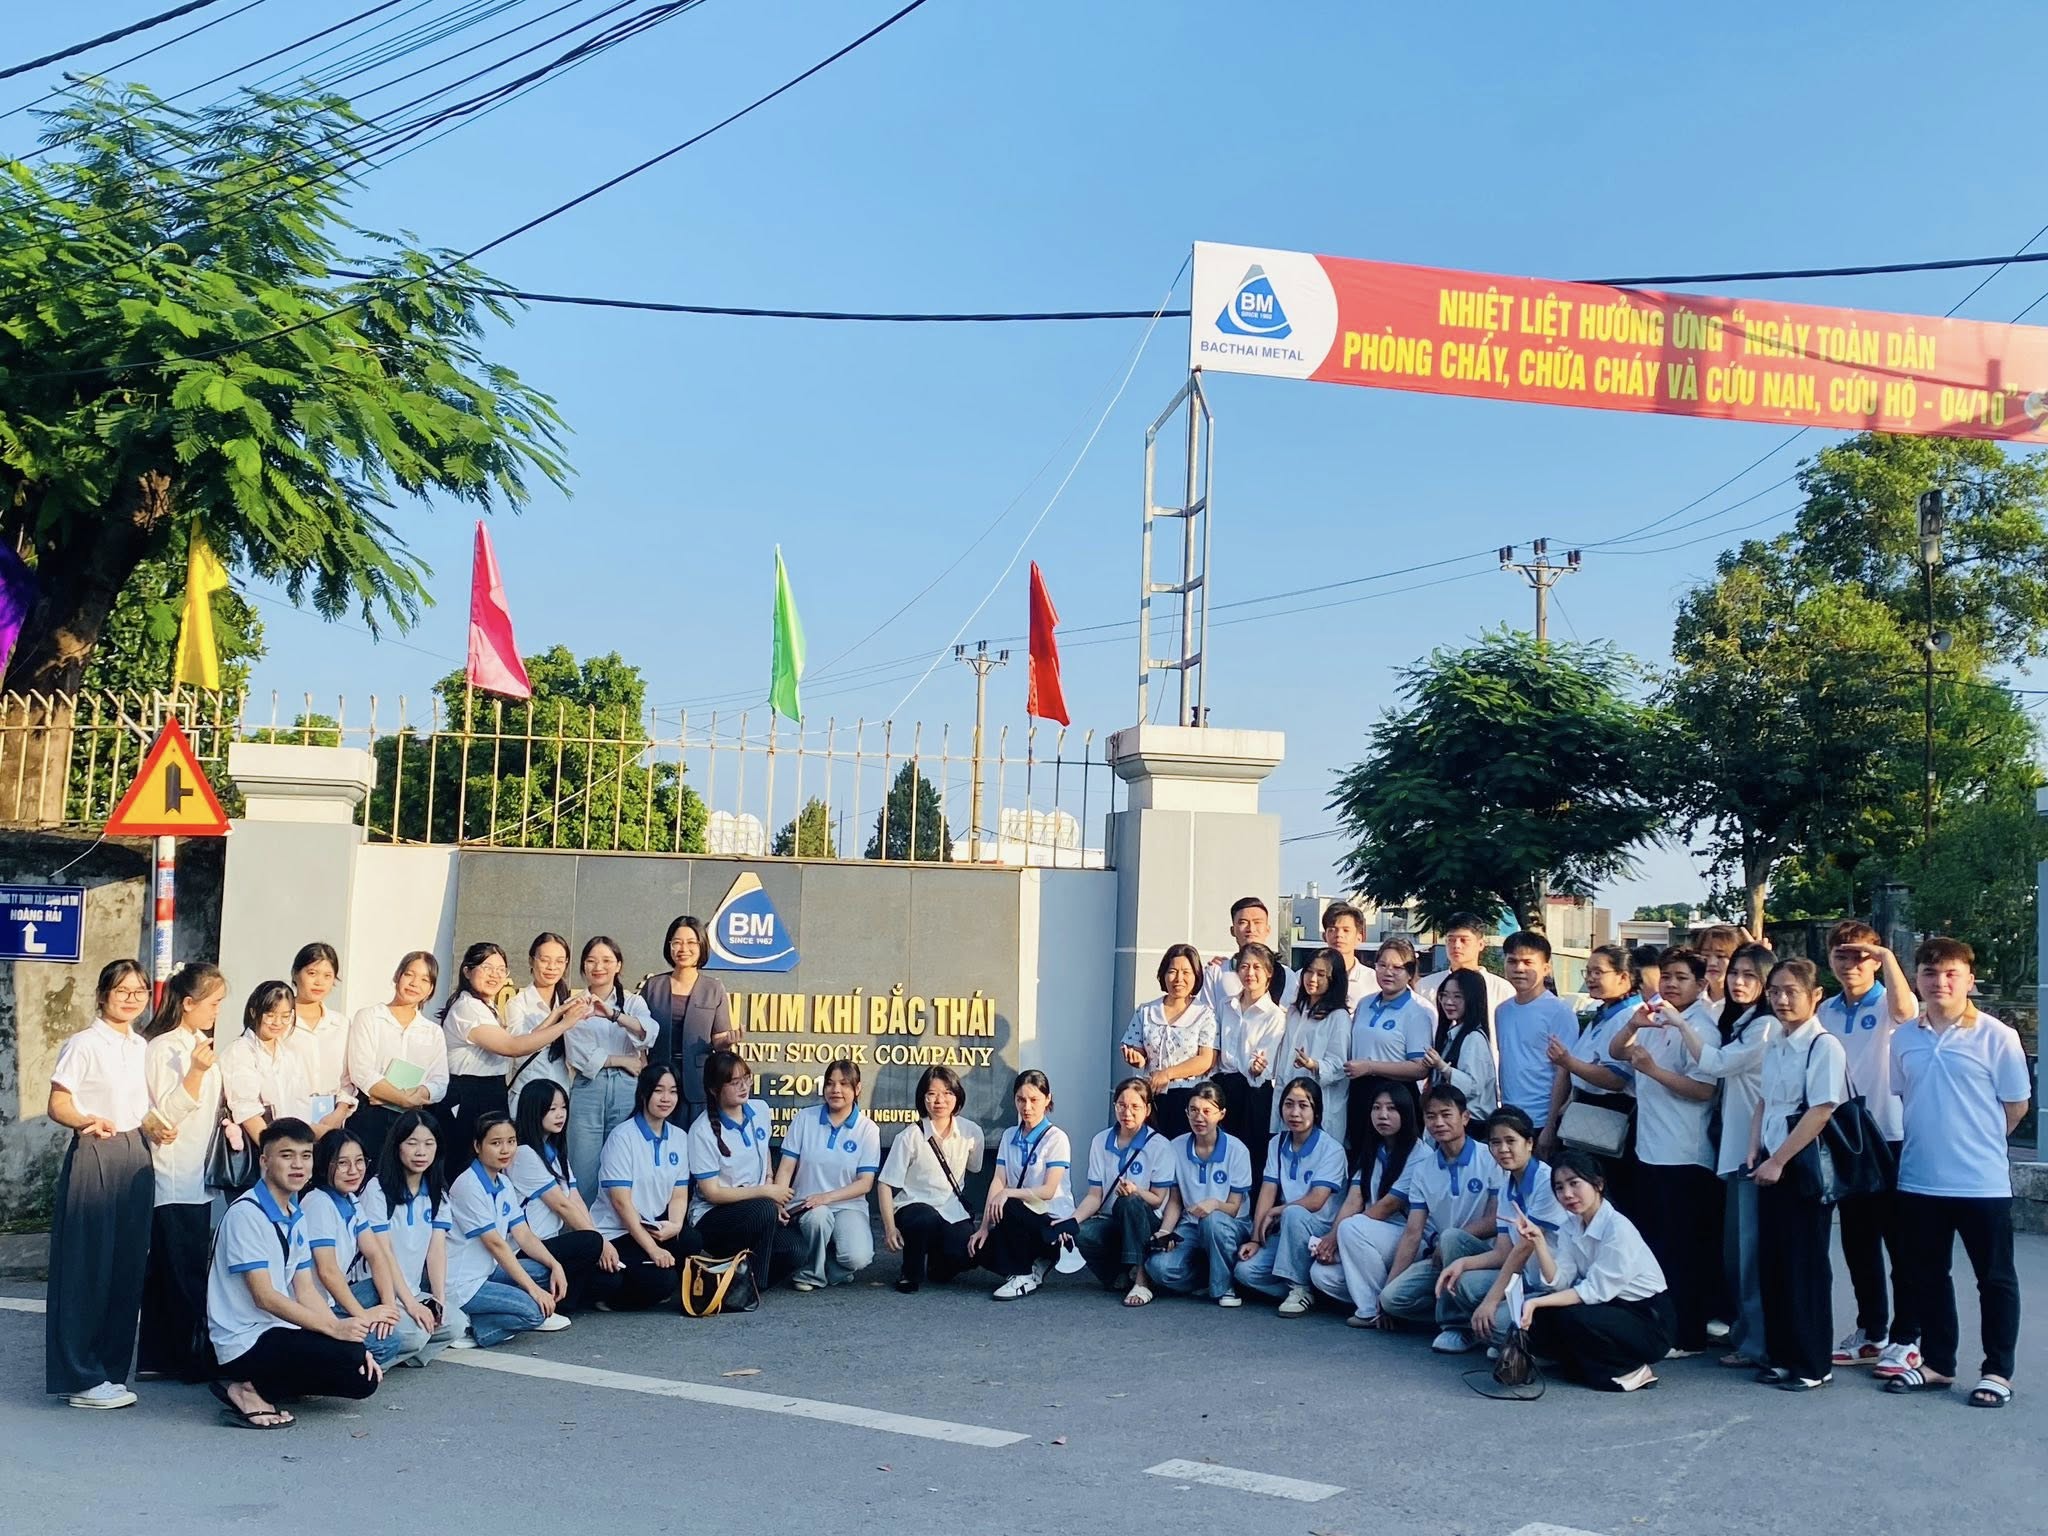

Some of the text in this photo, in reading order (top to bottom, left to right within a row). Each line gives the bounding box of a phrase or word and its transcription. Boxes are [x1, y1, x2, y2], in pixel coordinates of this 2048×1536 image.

[1241, 292, 1274, 313] BM
[1439, 286, 1514, 338] NHIỆT
[1520, 292, 1573, 344] LIỆT
[1579, 295, 1665, 347] HƯỞNG
[1672, 306, 1723, 352] ỨNG
[1817, 321, 1879, 366] TOÀN
[1887, 326, 1936, 371] DÂN
[1201, 341, 1304, 361] BACTHAI METAL
[1343, 326, 1433, 376] PHÒNG
[1440, 337, 1510, 388] CHÁY,
[1519, 346, 1586, 391] CHỮA
[1594, 352, 1660, 397] CHÁY
[1667, 357, 1698, 400] VÀ
[1706, 361, 1756, 406] CỨU
[1762, 370, 1821, 416] NẠN,
[1829, 371, 1878, 415] CỨU
[1884, 376, 1917, 426] HỘ
[10, 905, 62, 922] HOÀNG HẢI
[729, 912, 774, 937] BM
[729, 936, 754, 945] SINCE
[749, 992, 805, 1033] KIM
[813, 987, 863, 1034] KHÍ
[869, 983, 926, 1036] BẮC
[934, 989, 995, 1037] THÁI
[786, 1042, 869, 1064] STOCK
[874, 1044, 995, 1067] COMPANY
[769, 1074, 826, 1096] :201
[873, 1109, 920, 1123] NGUYEN
